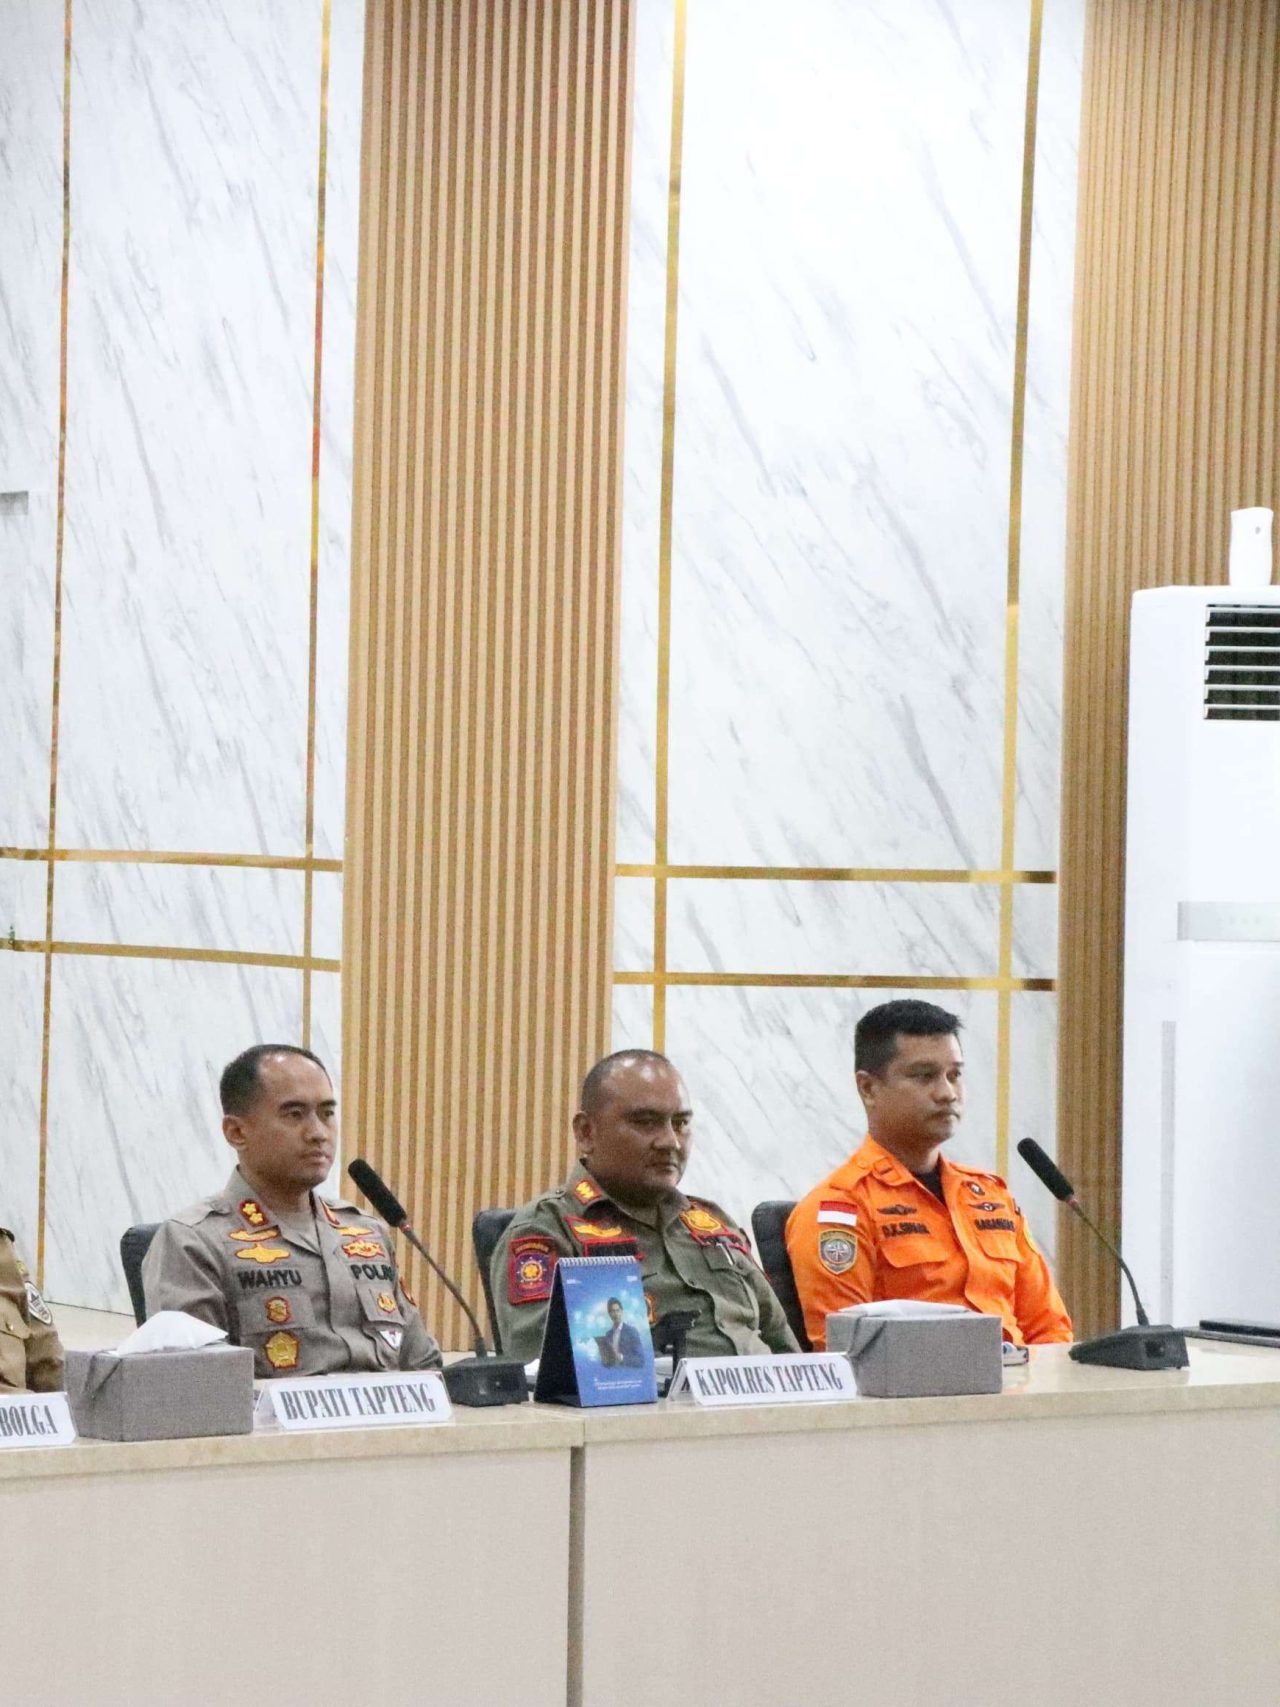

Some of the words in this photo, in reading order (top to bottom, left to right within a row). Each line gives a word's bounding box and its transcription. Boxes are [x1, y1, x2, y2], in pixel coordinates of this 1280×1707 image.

[237, 1269, 303, 1289] WAHYU
[695, 1366, 776, 1397] KAPOLRES
[773, 1362, 843, 1393] TAPTENG
[279, 1387, 351, 1421] BUPATI
[348, 1382, 436, 1415] TAPTENG
